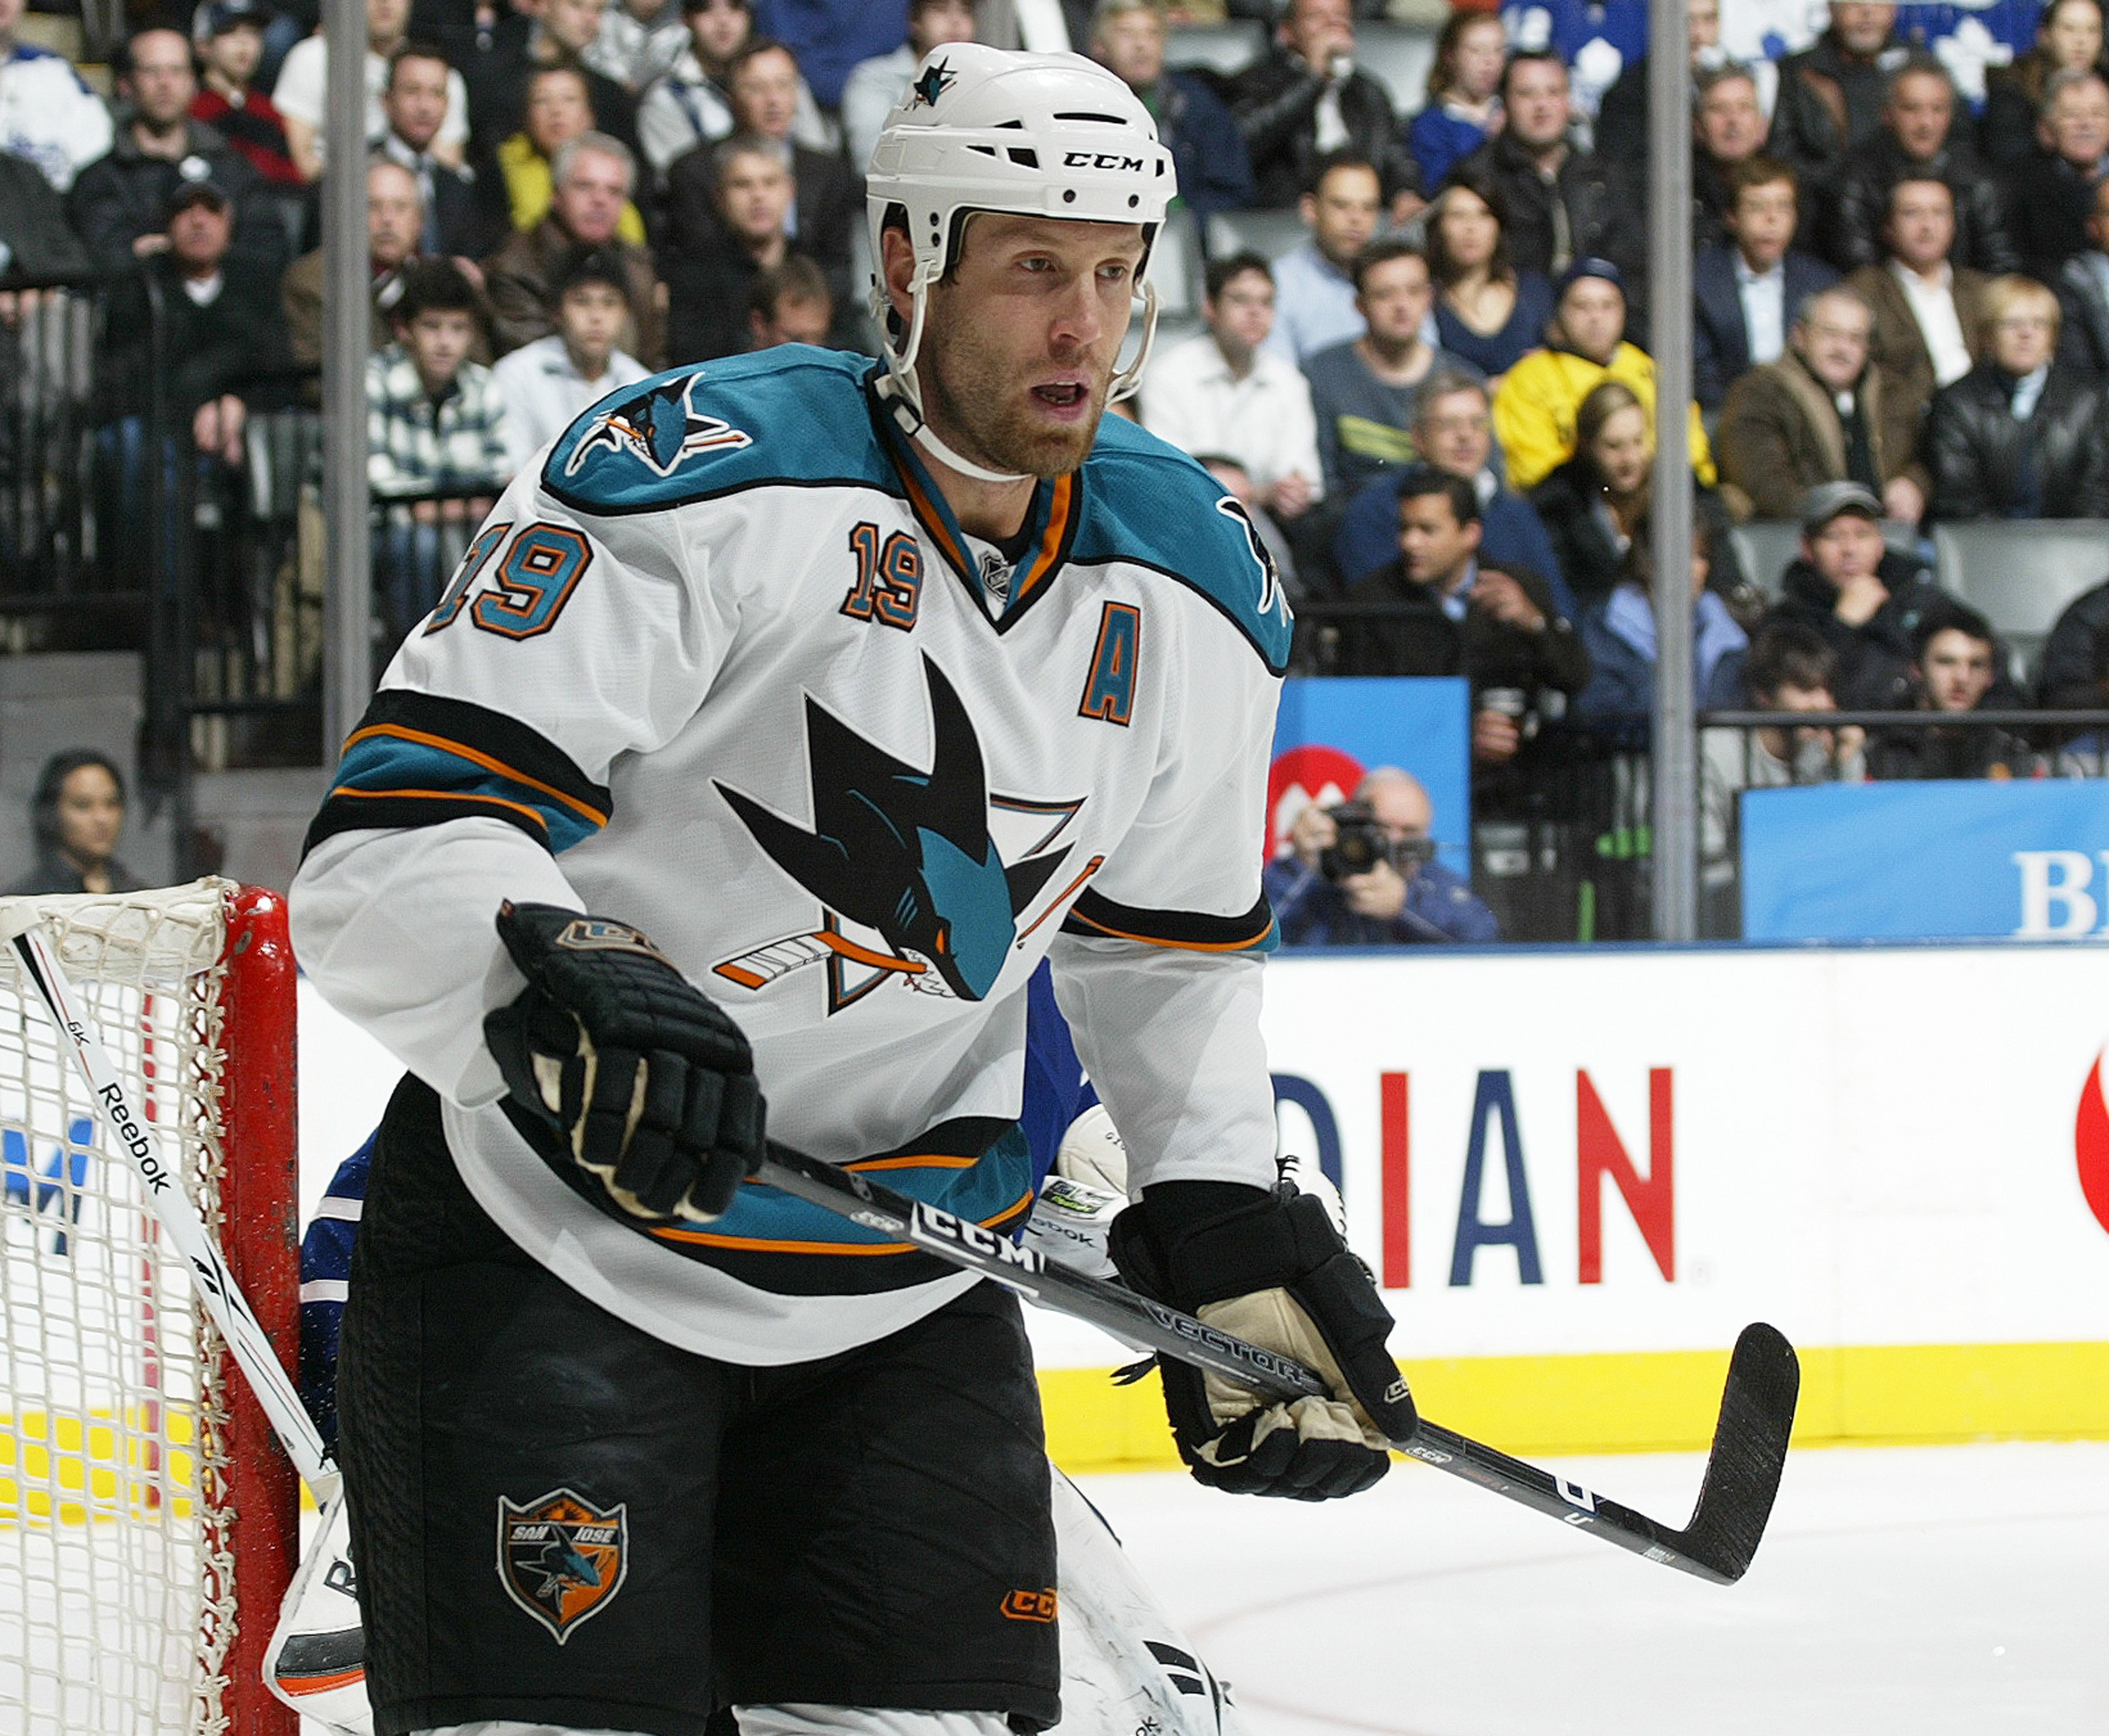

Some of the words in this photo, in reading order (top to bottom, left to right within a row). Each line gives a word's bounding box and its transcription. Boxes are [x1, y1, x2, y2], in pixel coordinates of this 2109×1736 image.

[1063, 152, 1144, 172] CCM
[421, 521, 594, 641] 19
[838, 520, 924, 633] 19
[1077, 600, 1141, 727] A
[98, 1082, 172, 1195] Reebok
[918, 1202, 1037, 1274] CCM
[1140, 1297, 1304, 1386] VECTOR
[510, 1525, 550, 1540] SAN
